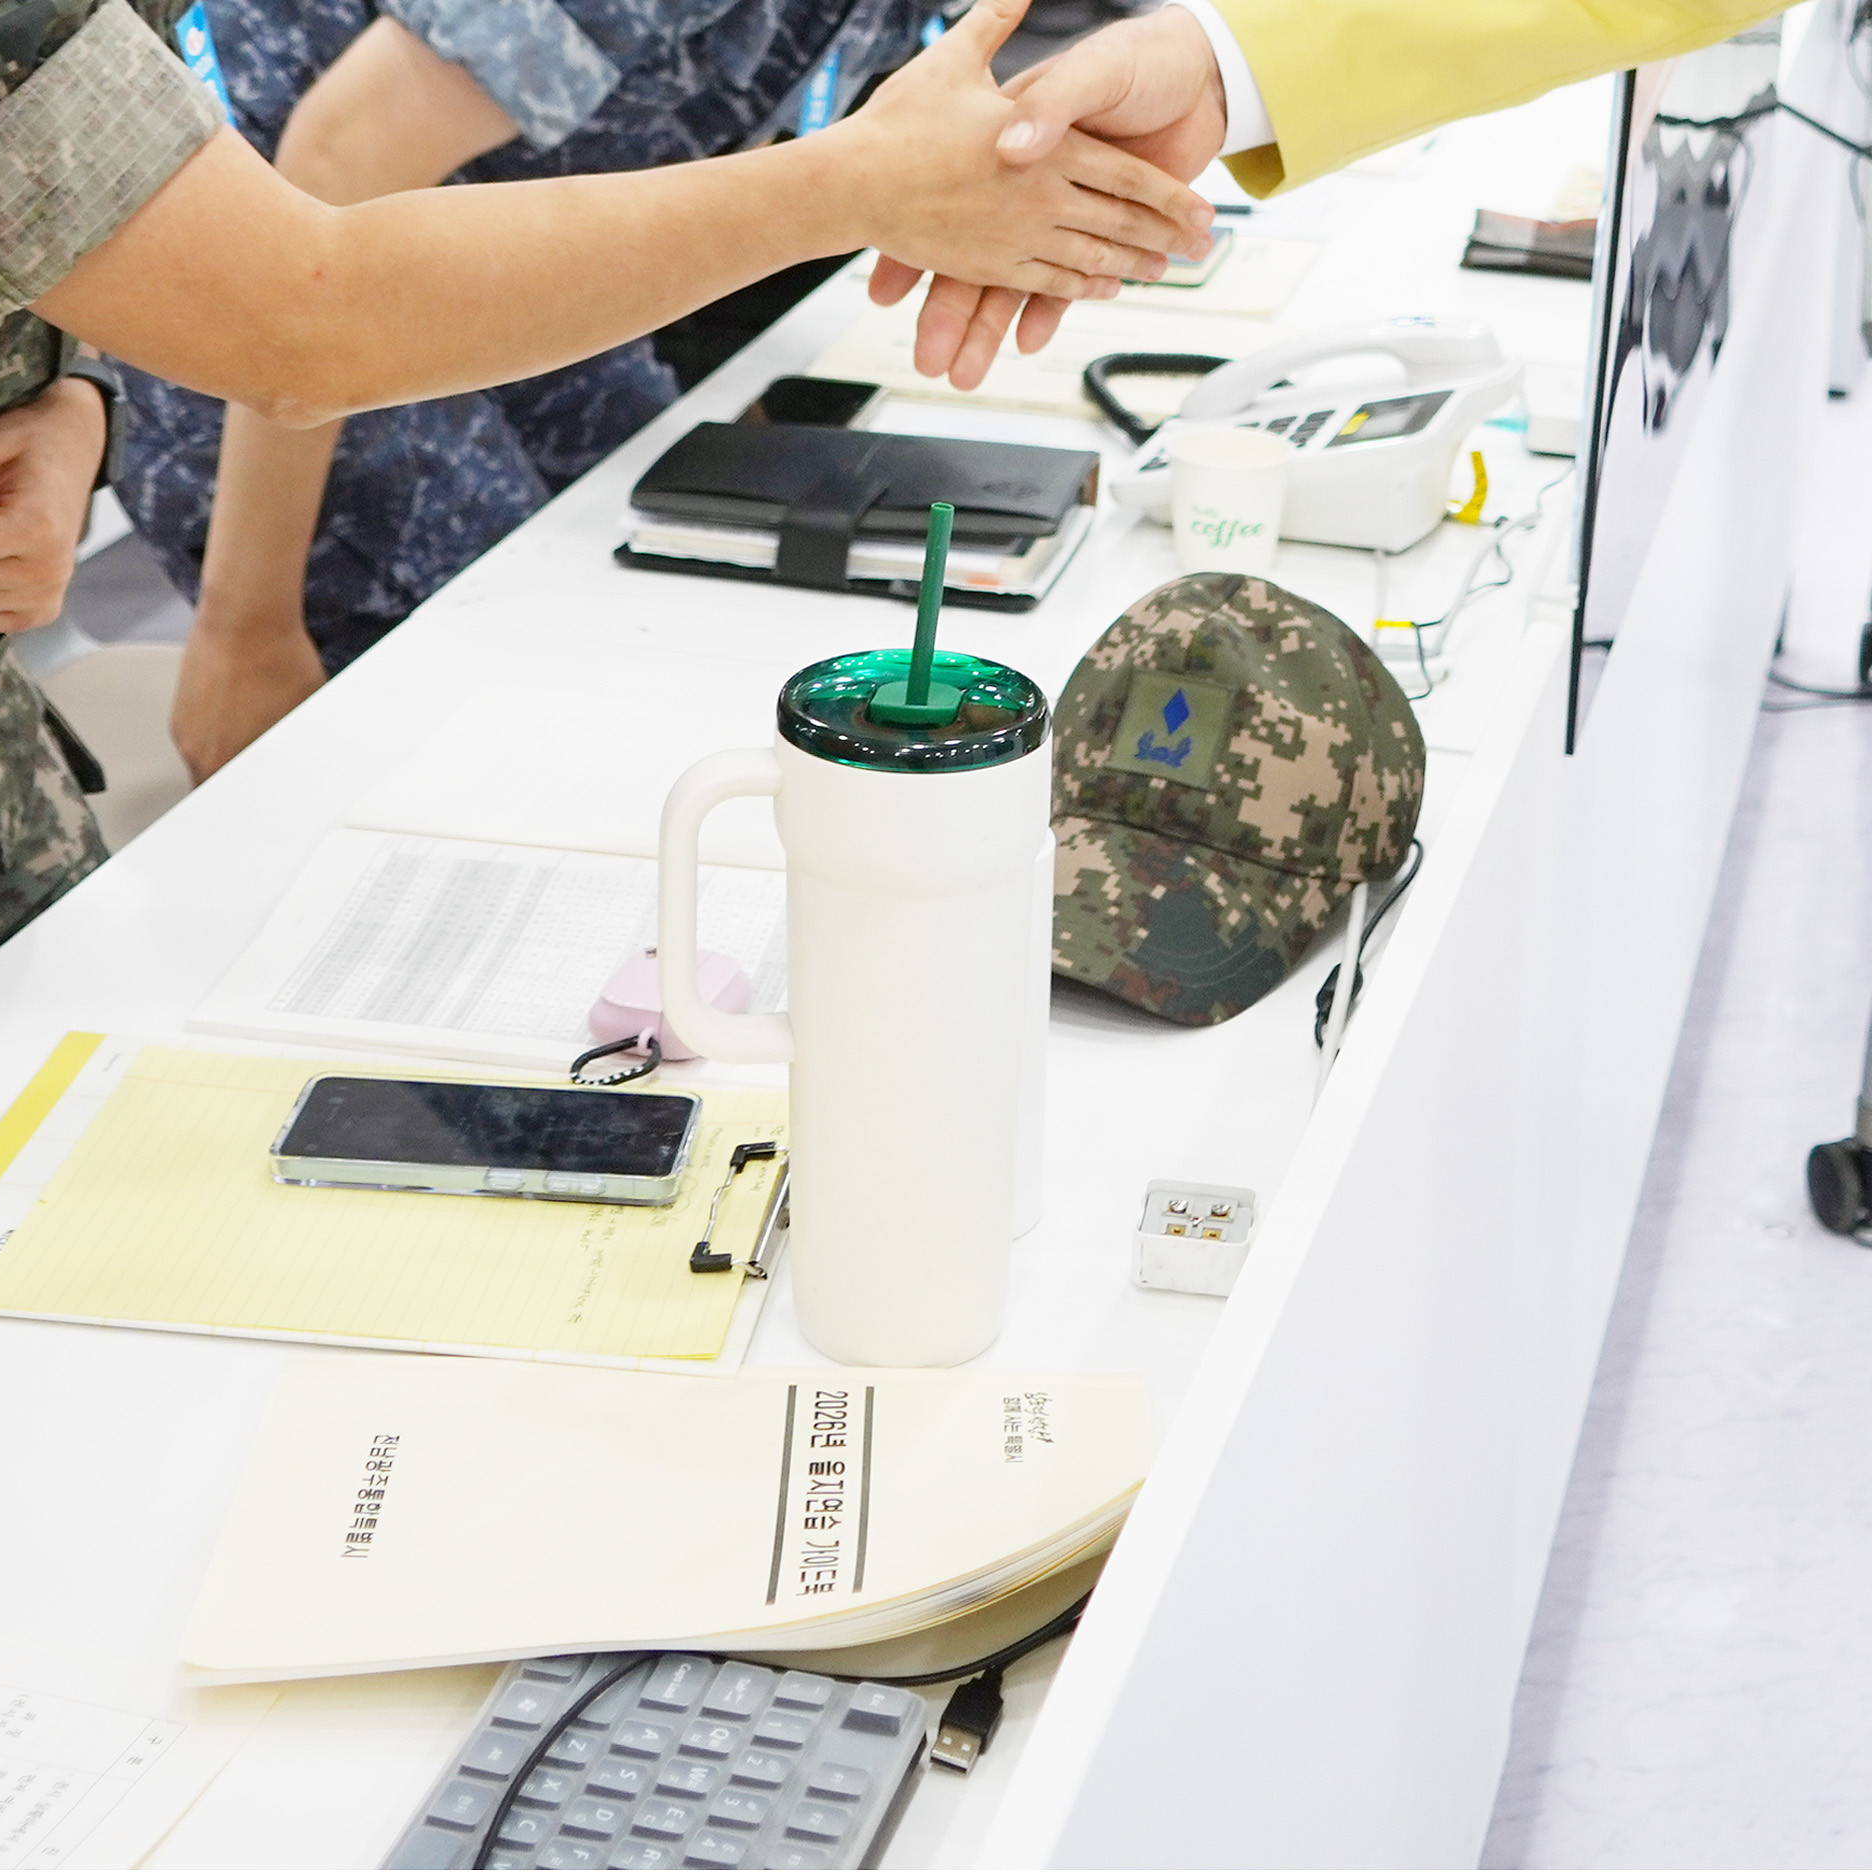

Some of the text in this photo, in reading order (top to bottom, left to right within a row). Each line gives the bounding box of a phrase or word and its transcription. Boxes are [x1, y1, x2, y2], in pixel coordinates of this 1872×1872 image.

[1191, 520, 1263, 549] coffee
[339, 1432, 402, 1560] 전남광주통합특별시
[796, 1390, 848, 1596] 2026년 을지연습 가이드북
